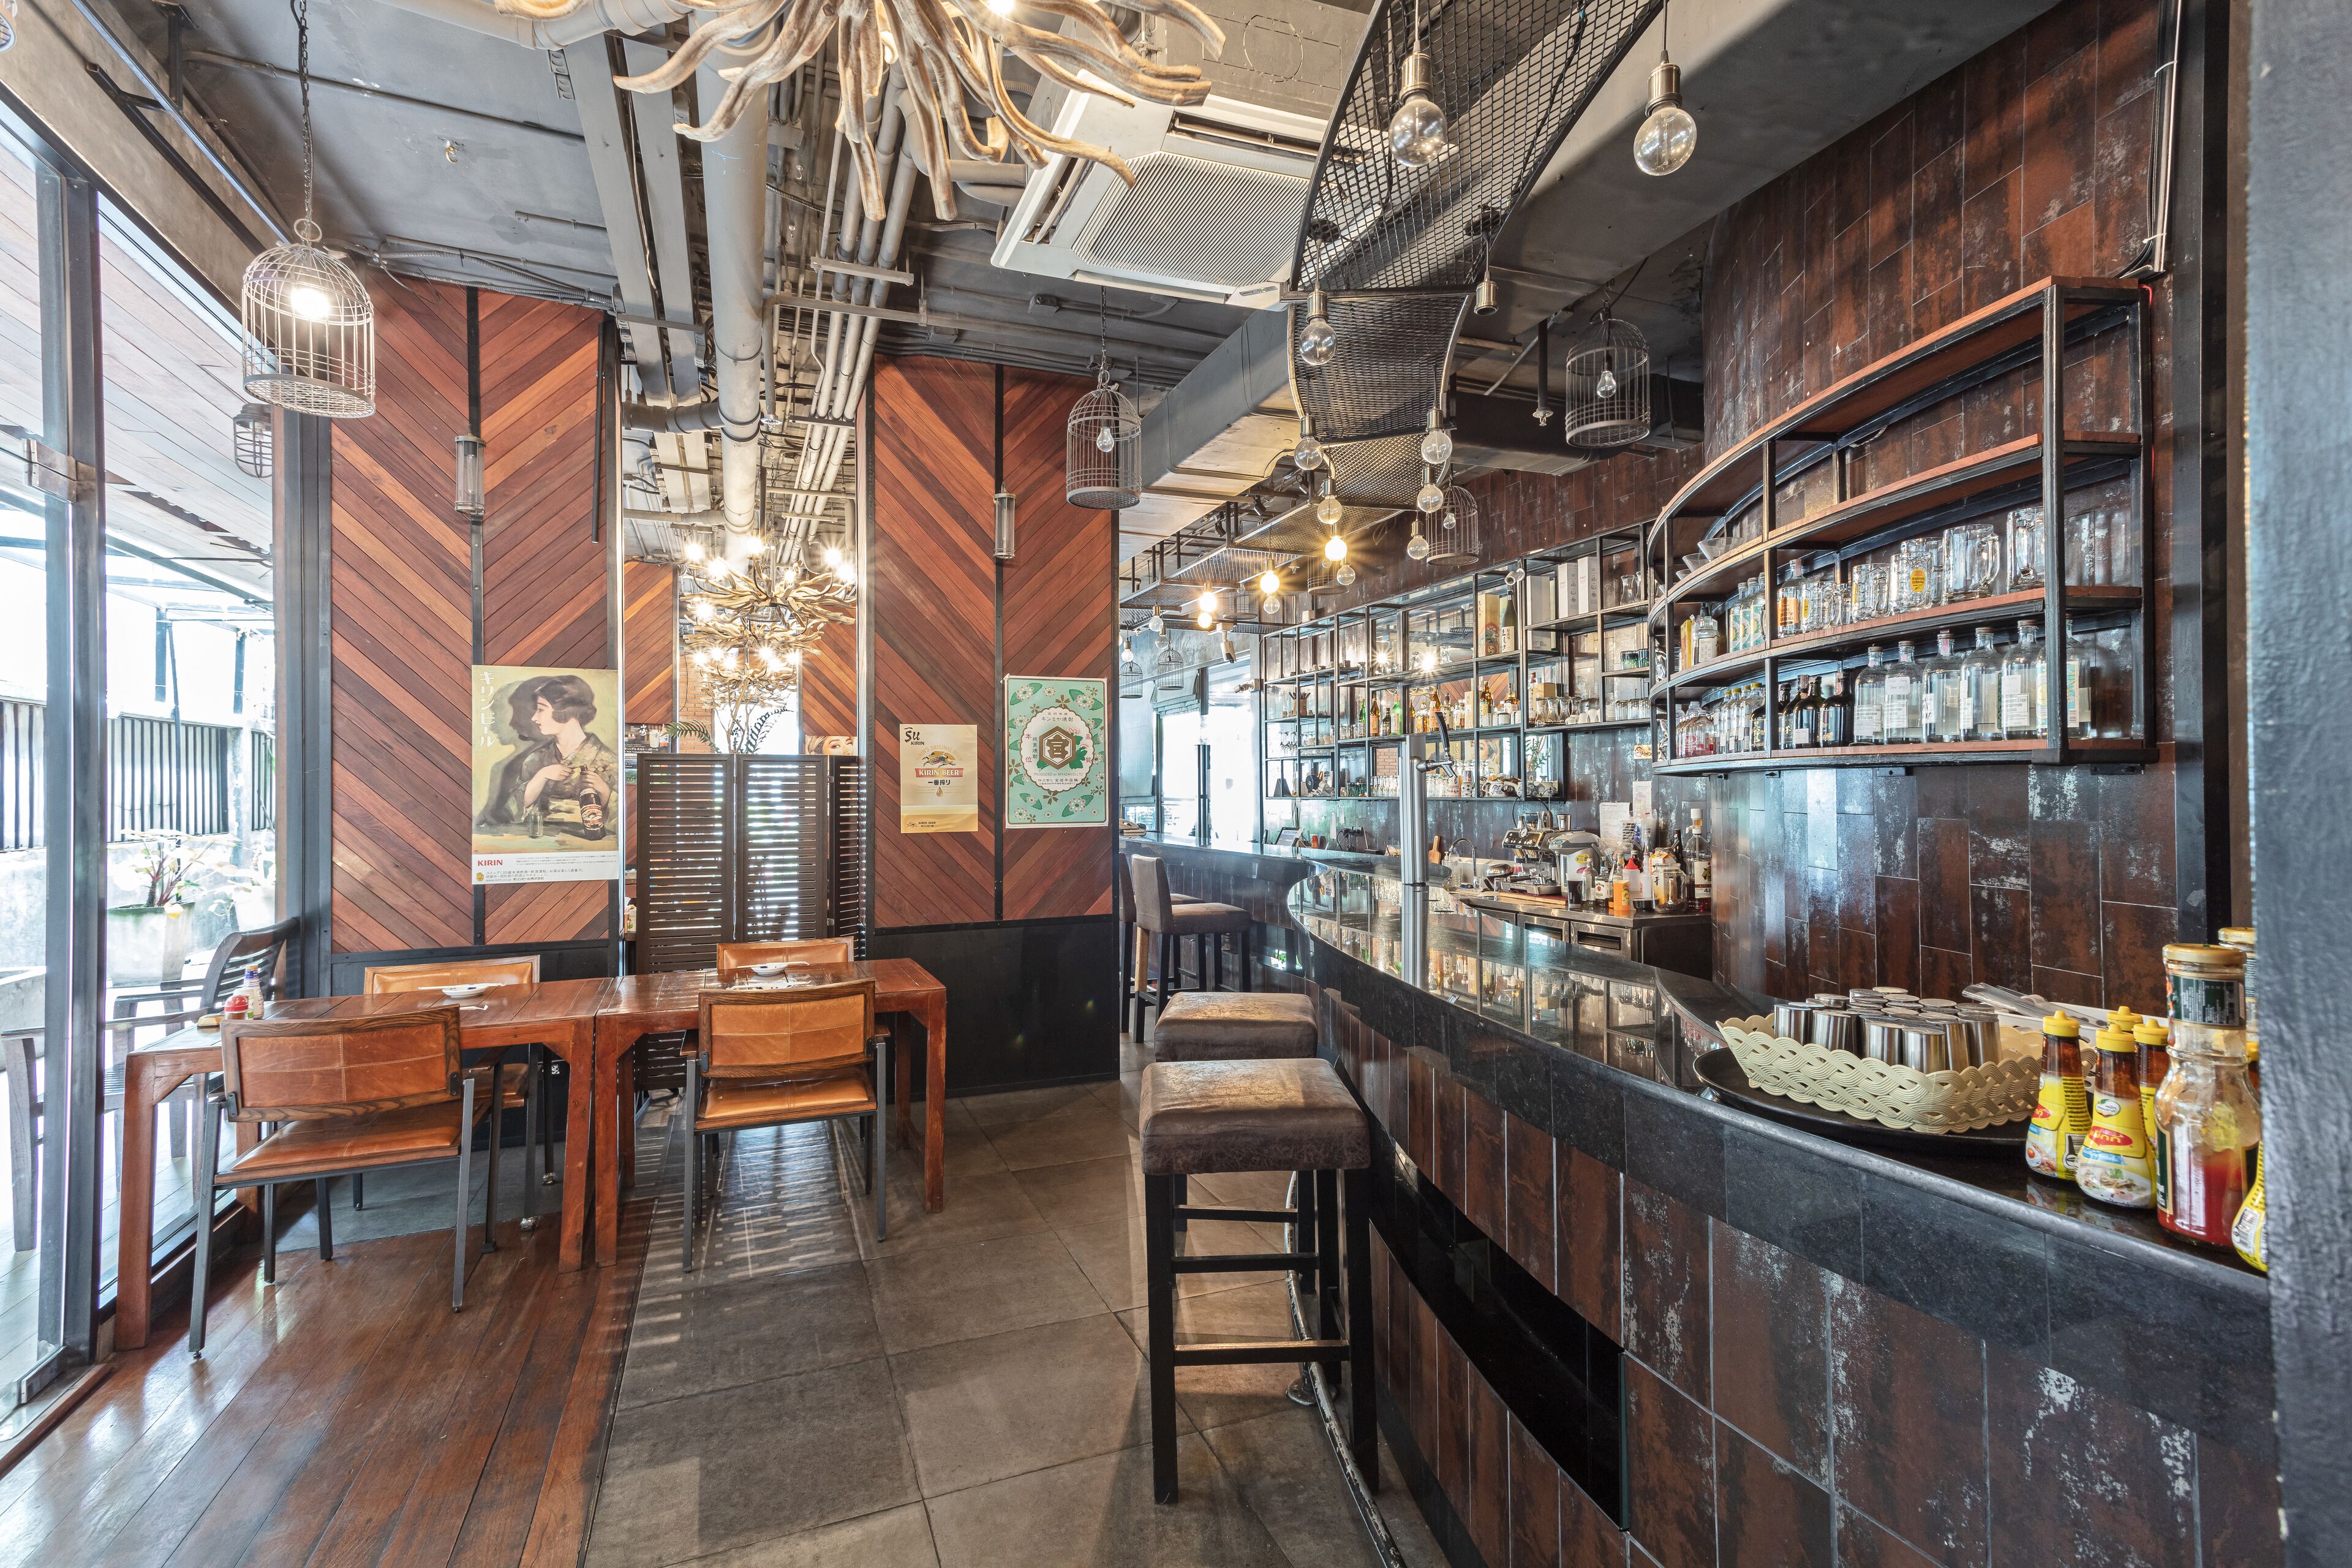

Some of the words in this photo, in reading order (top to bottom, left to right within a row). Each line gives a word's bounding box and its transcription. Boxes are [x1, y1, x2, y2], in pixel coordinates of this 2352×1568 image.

[479, 671, 497, 748] キリンビール
